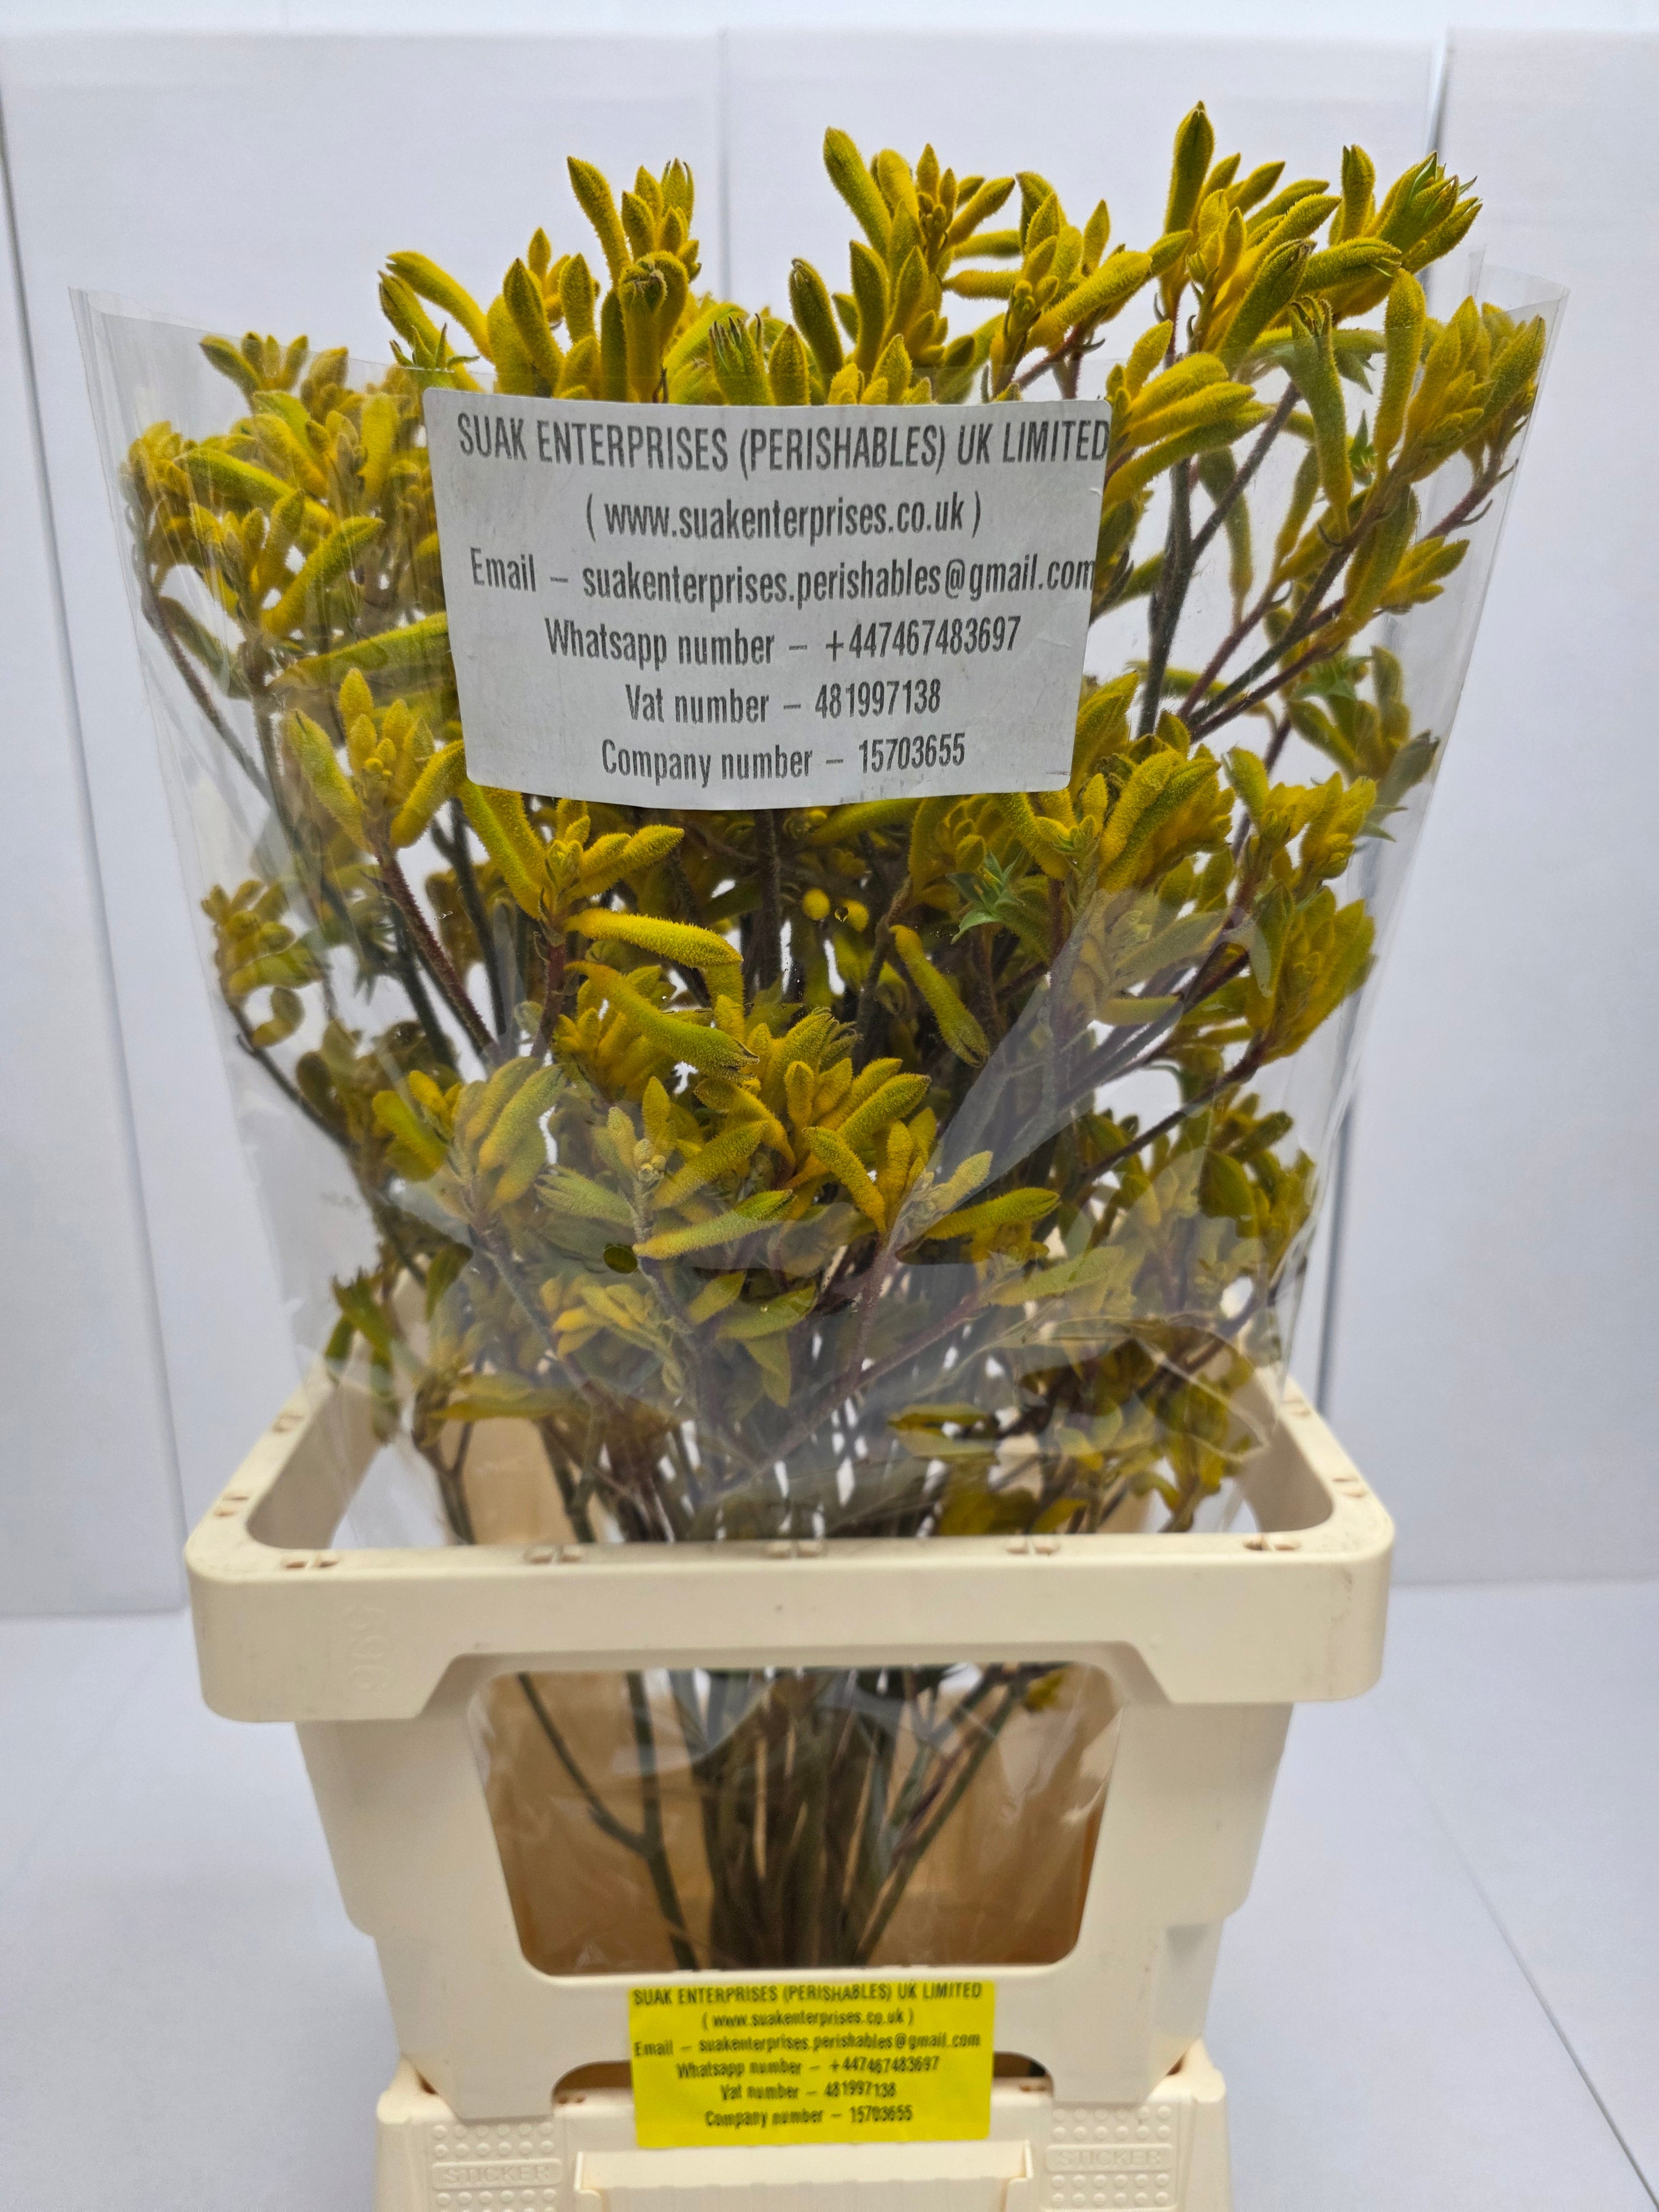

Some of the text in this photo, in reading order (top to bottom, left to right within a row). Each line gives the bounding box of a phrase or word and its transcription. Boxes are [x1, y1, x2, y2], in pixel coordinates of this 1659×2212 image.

[458, 413, 1109, 481] SUAK ENTERPRISES (PERISHABLES) UK LIMITED
[604, 491, 964, 546] www.suakenterprises.co.uk
[471, 547, 536, 592] Email
[582, 553, 1095, 612] suakenterprises.perishables@gmail.com
[545, 618, 666, 671] Whatsapp
[679, 628, 775, 665] number
[826, 615, 1021, 661] +447467483697
[625, 684, 664, 723] Vat
[675, 688, 769, 724] number
[815, 678, 941, 718] 481997138
[602, 739, 711, 788] Company
[722, 744, 812, 780] number
[859, 732, 965, 773] 15703655
[633, 1982, 983, 2006] SUAK ENTERPRISES (PERISHABLES) UK LIMITED
[634, 2040, 673, 2057] Email
[676, 2061, 745, 2079] Whatsapp
[750, 2058, 801, 2075] number
[721, 2084, 742, 2100] Vat
[747, 2083, 799, 2100] number
[705, 2111, 768, 2129] Company
[773, 2109, 823, 2125] number
